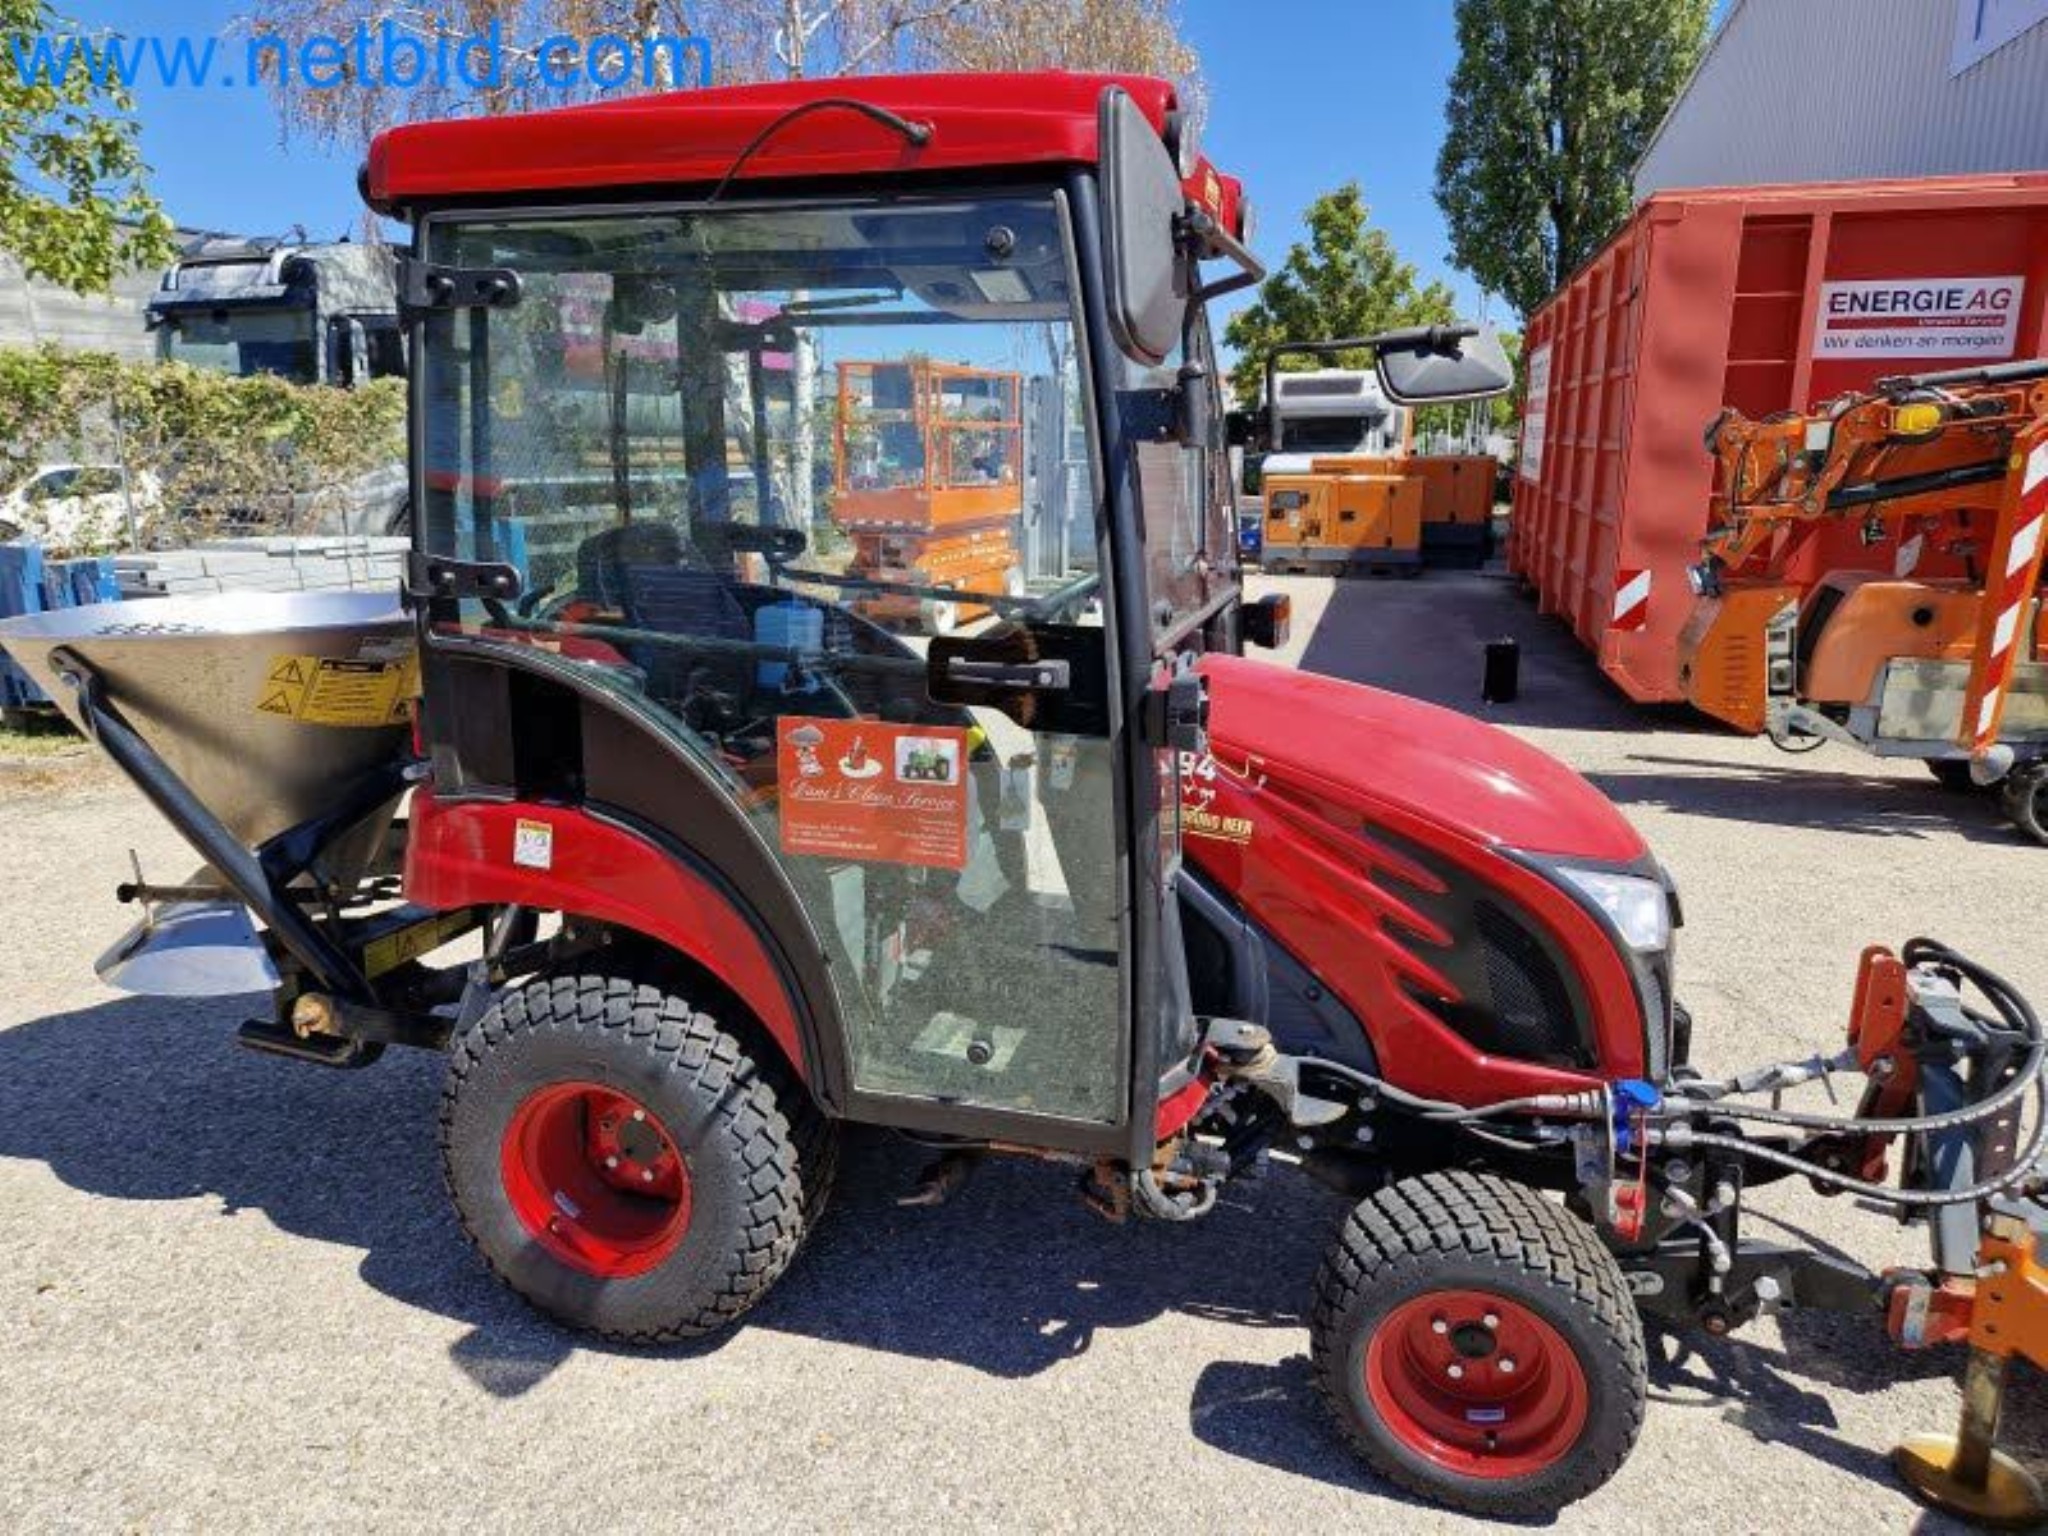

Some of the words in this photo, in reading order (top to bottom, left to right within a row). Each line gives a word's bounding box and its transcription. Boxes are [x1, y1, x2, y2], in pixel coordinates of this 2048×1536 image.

[1828, 288, 1963, 313] ENERGIE
[1966, 288, 2012, 310] AG
[1854, 333, 1913, 349] denken
[1941, 333, 2005, 350] morgen
